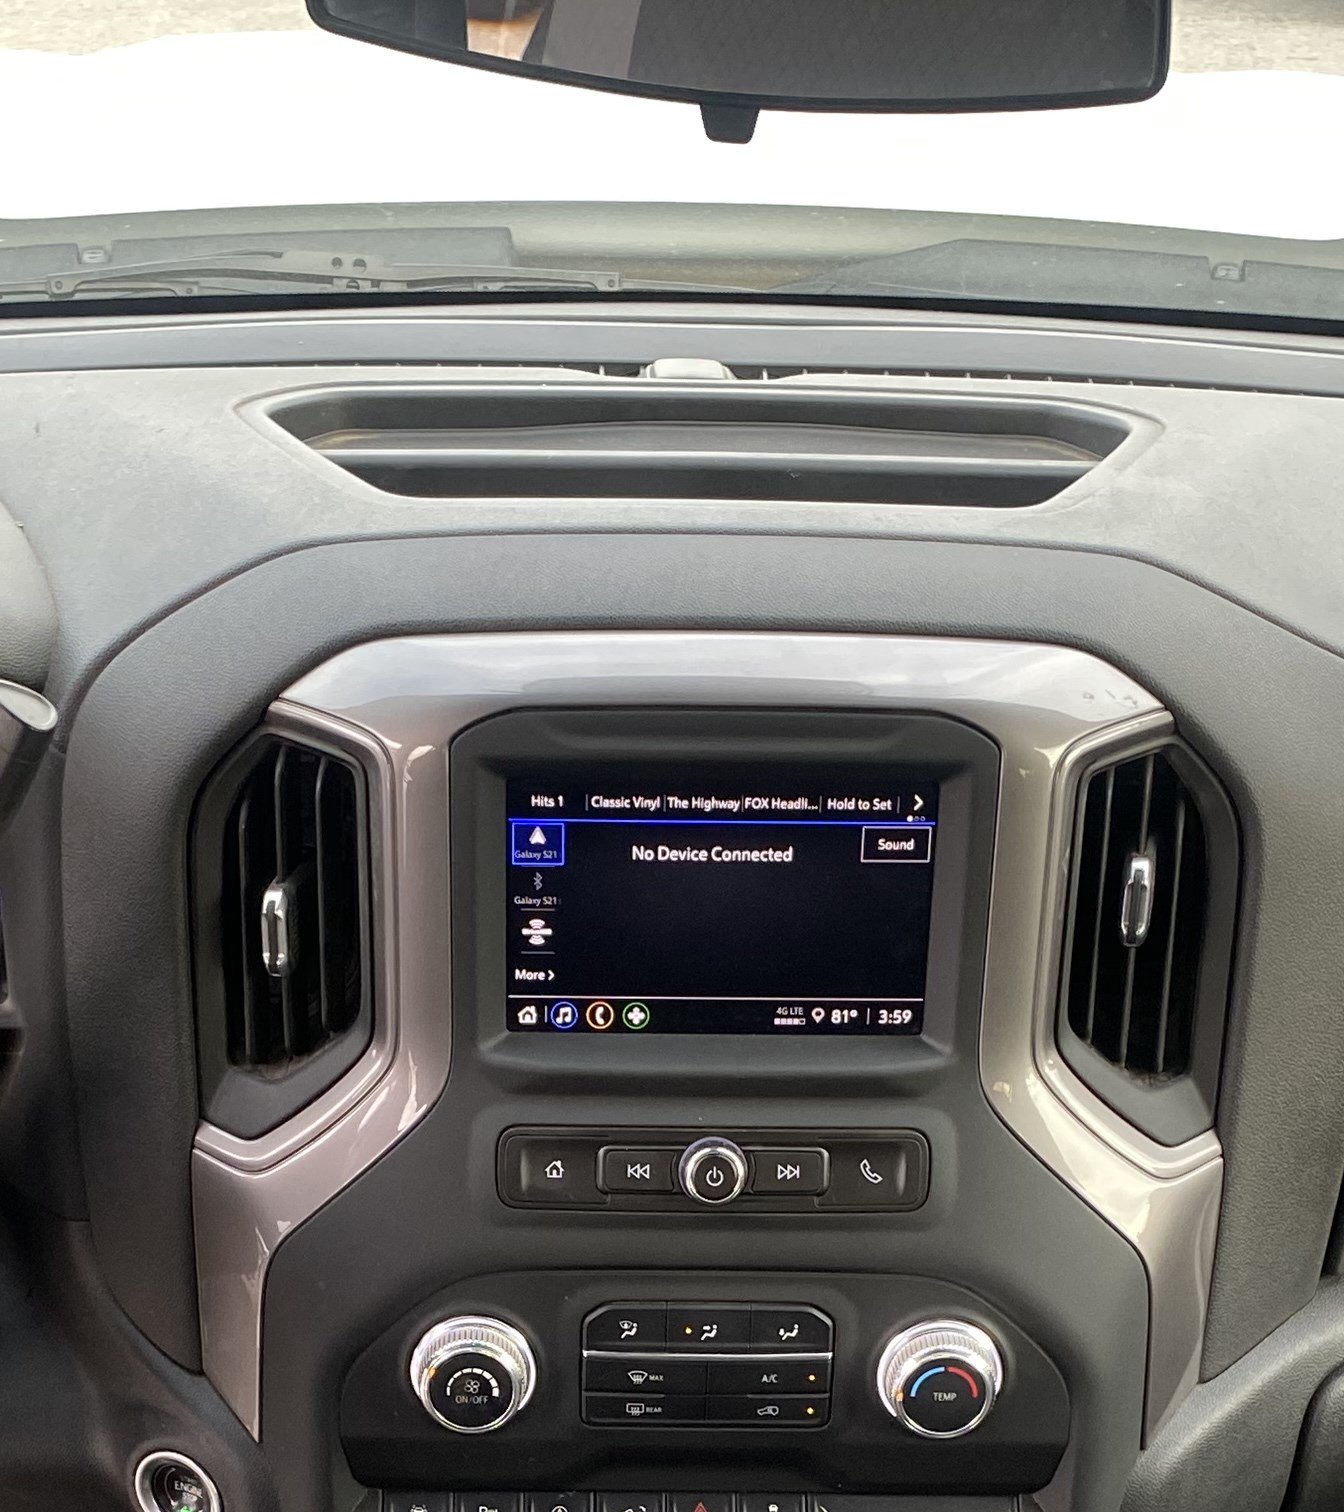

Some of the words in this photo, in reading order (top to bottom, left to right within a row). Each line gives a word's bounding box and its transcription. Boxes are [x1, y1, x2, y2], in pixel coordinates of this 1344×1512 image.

[530, 795, 555, 808] Hits
[558, 795, 564, 808] 1
[590, 795, 631, 809] Classic
[632, 796, 661, 813] Vinyl
[667, 796, 690, 809] The
[691, 796, 741, 813] Highway
[744, 797, 769, 810] FOX
[827, 797, 856, 811] Hold
[857, 799, 870, 811] to
[872, 798, 893, 811] Set
[877, 838, 915, 851] Sound
[514, 849, 542, 861] Galaxy
[542, 850, 558, 859] S21
[632, 845, 655, 861] No
[657, 844, 709, 861] Device
[710, 845, 794, 863] Connected
[513, 895, 542, 907] Galaxy
[514, 968, 546, 981] More
[775, 1006, 789, 1016] 4G
[789, 1006, 804, 1016] LTE
[877, 1009, 913, 1025] 3:59
[648, 1374, 665, 1382] MAX
[761, 1373, 779, 1384] A/C
[932, 1391, 958, 1402] TEMP
[645, 1406, 663, 1414] REAR
